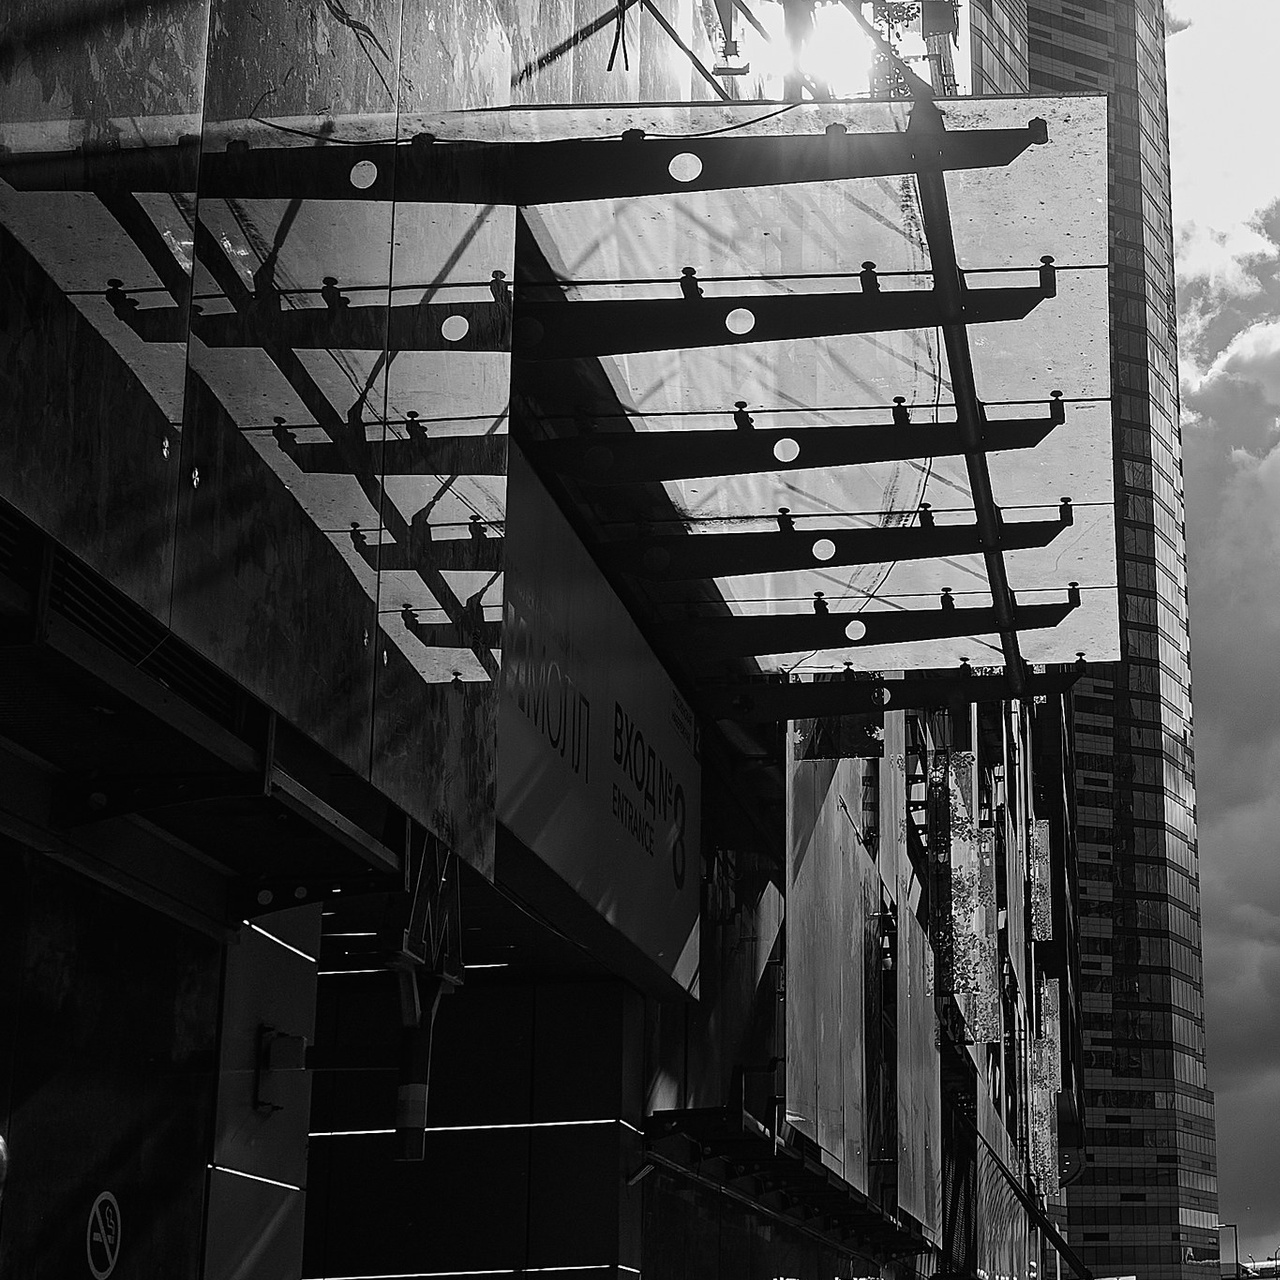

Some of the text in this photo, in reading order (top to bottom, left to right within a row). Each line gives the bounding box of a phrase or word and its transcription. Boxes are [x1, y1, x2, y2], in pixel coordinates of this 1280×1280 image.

[613, 701, 656, 821] ВХОД
[673, 783, 686, 890] 8
[613, 783, 655, 857] ENTRANCE
